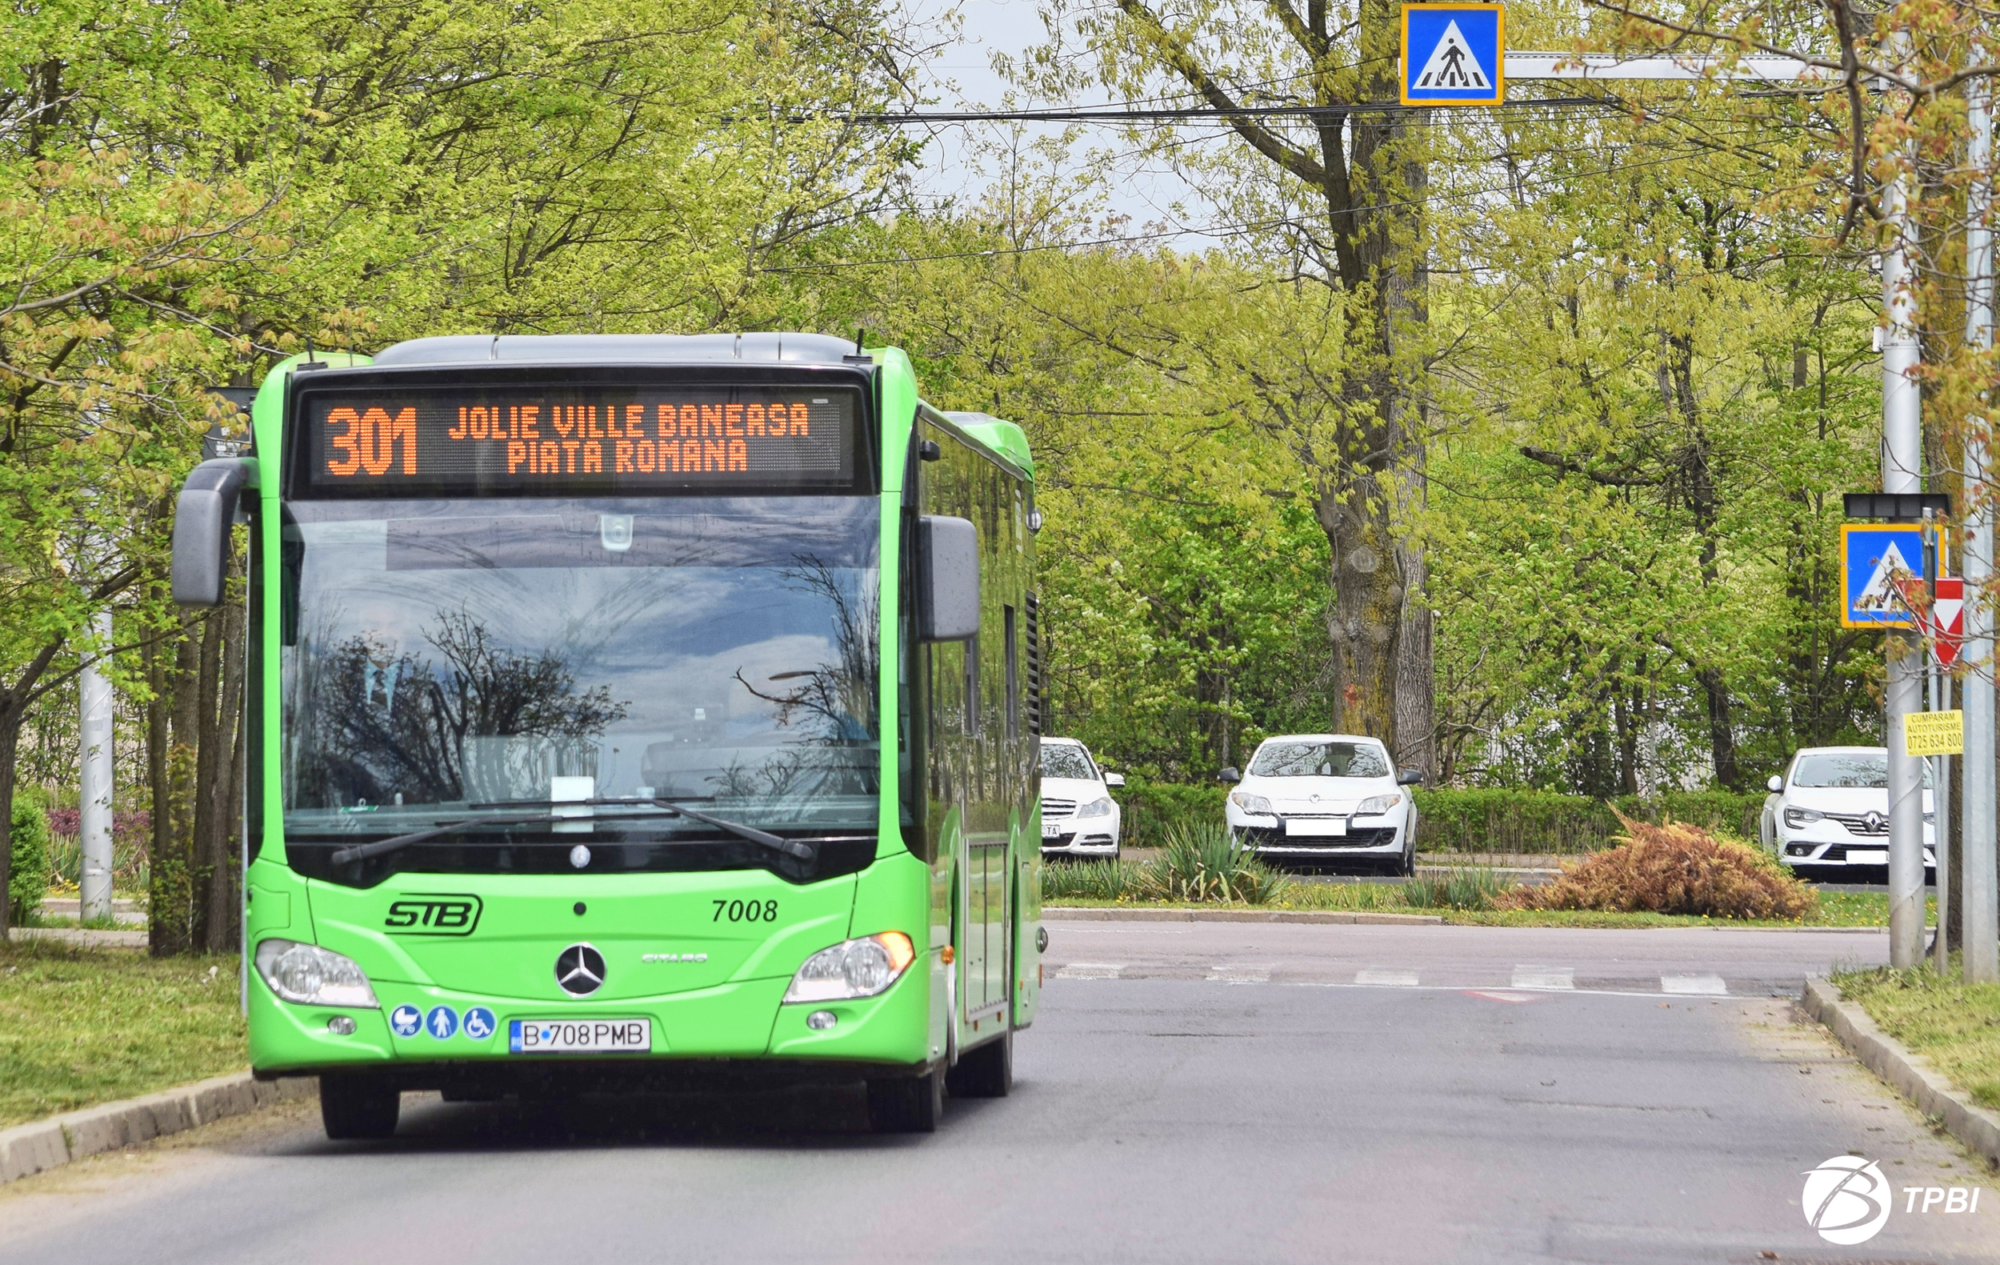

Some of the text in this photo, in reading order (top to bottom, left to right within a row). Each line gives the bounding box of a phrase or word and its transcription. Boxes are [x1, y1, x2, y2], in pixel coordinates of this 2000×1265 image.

[448, 403, 808, 439] JOLIE VILLE BANEASA
[328, 407, 416, 475] 301
[507, 439, 748, 473] PIATA ROMANA
[1908, 722, 1961, 733] AUTOTURISME
[1911, 713, 1955, 723] CUMPARAM
[1907, 733, 1962, 750] 0725 634 800
[384, 901, 472, 927] STB
[713, 899, 778, 922] 7008
